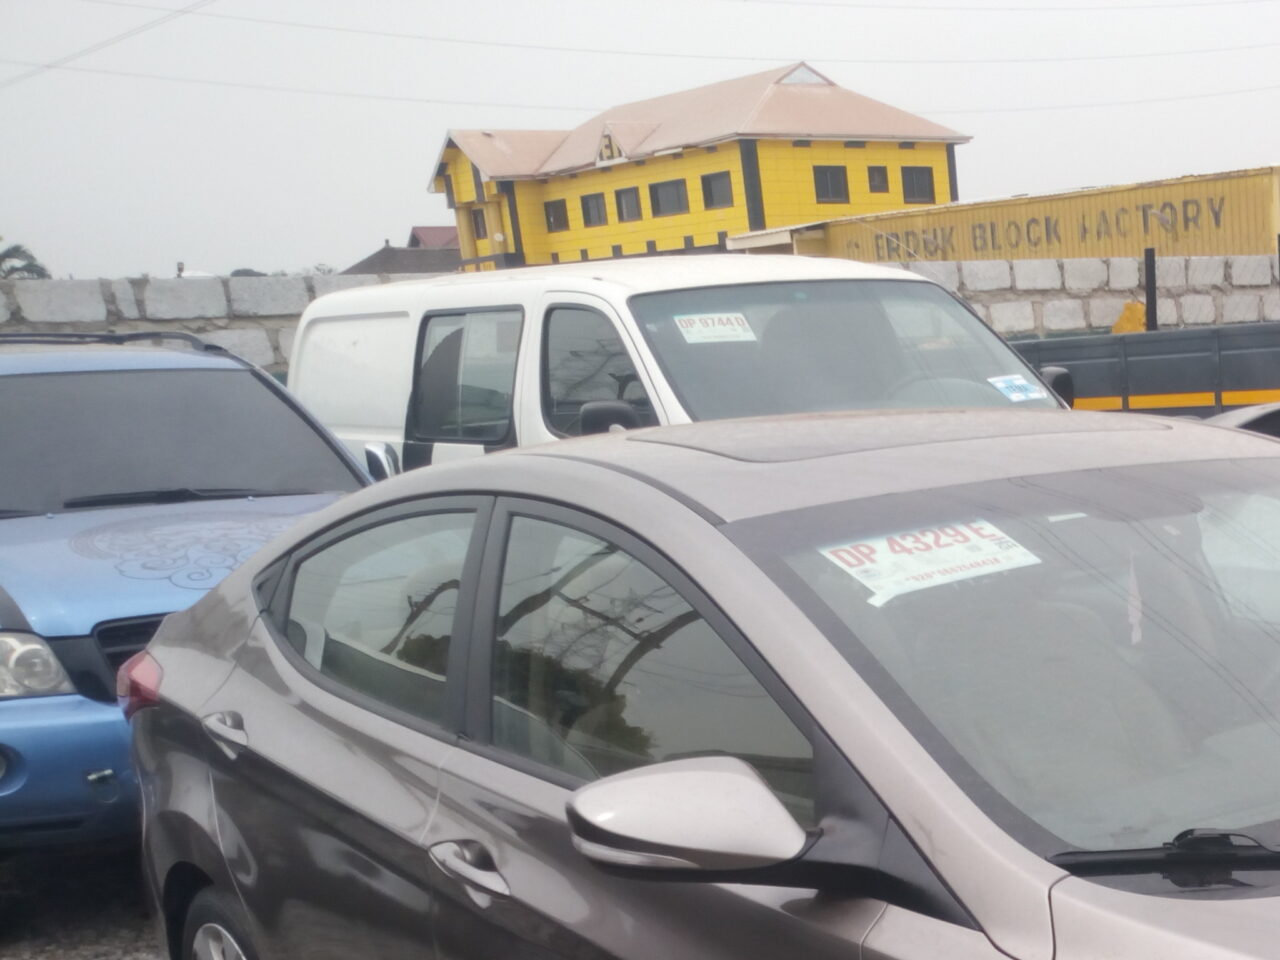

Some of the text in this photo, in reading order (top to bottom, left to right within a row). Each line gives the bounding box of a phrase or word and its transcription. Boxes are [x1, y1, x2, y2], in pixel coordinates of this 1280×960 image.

[874, 226, 956, 261] ERDUK
[971, 215, 1061, 252] BLOCK
[678, 318, 696, 329] DP
[829, 543, 877, 569] DP
[885, 524, 970, 557] 4329
